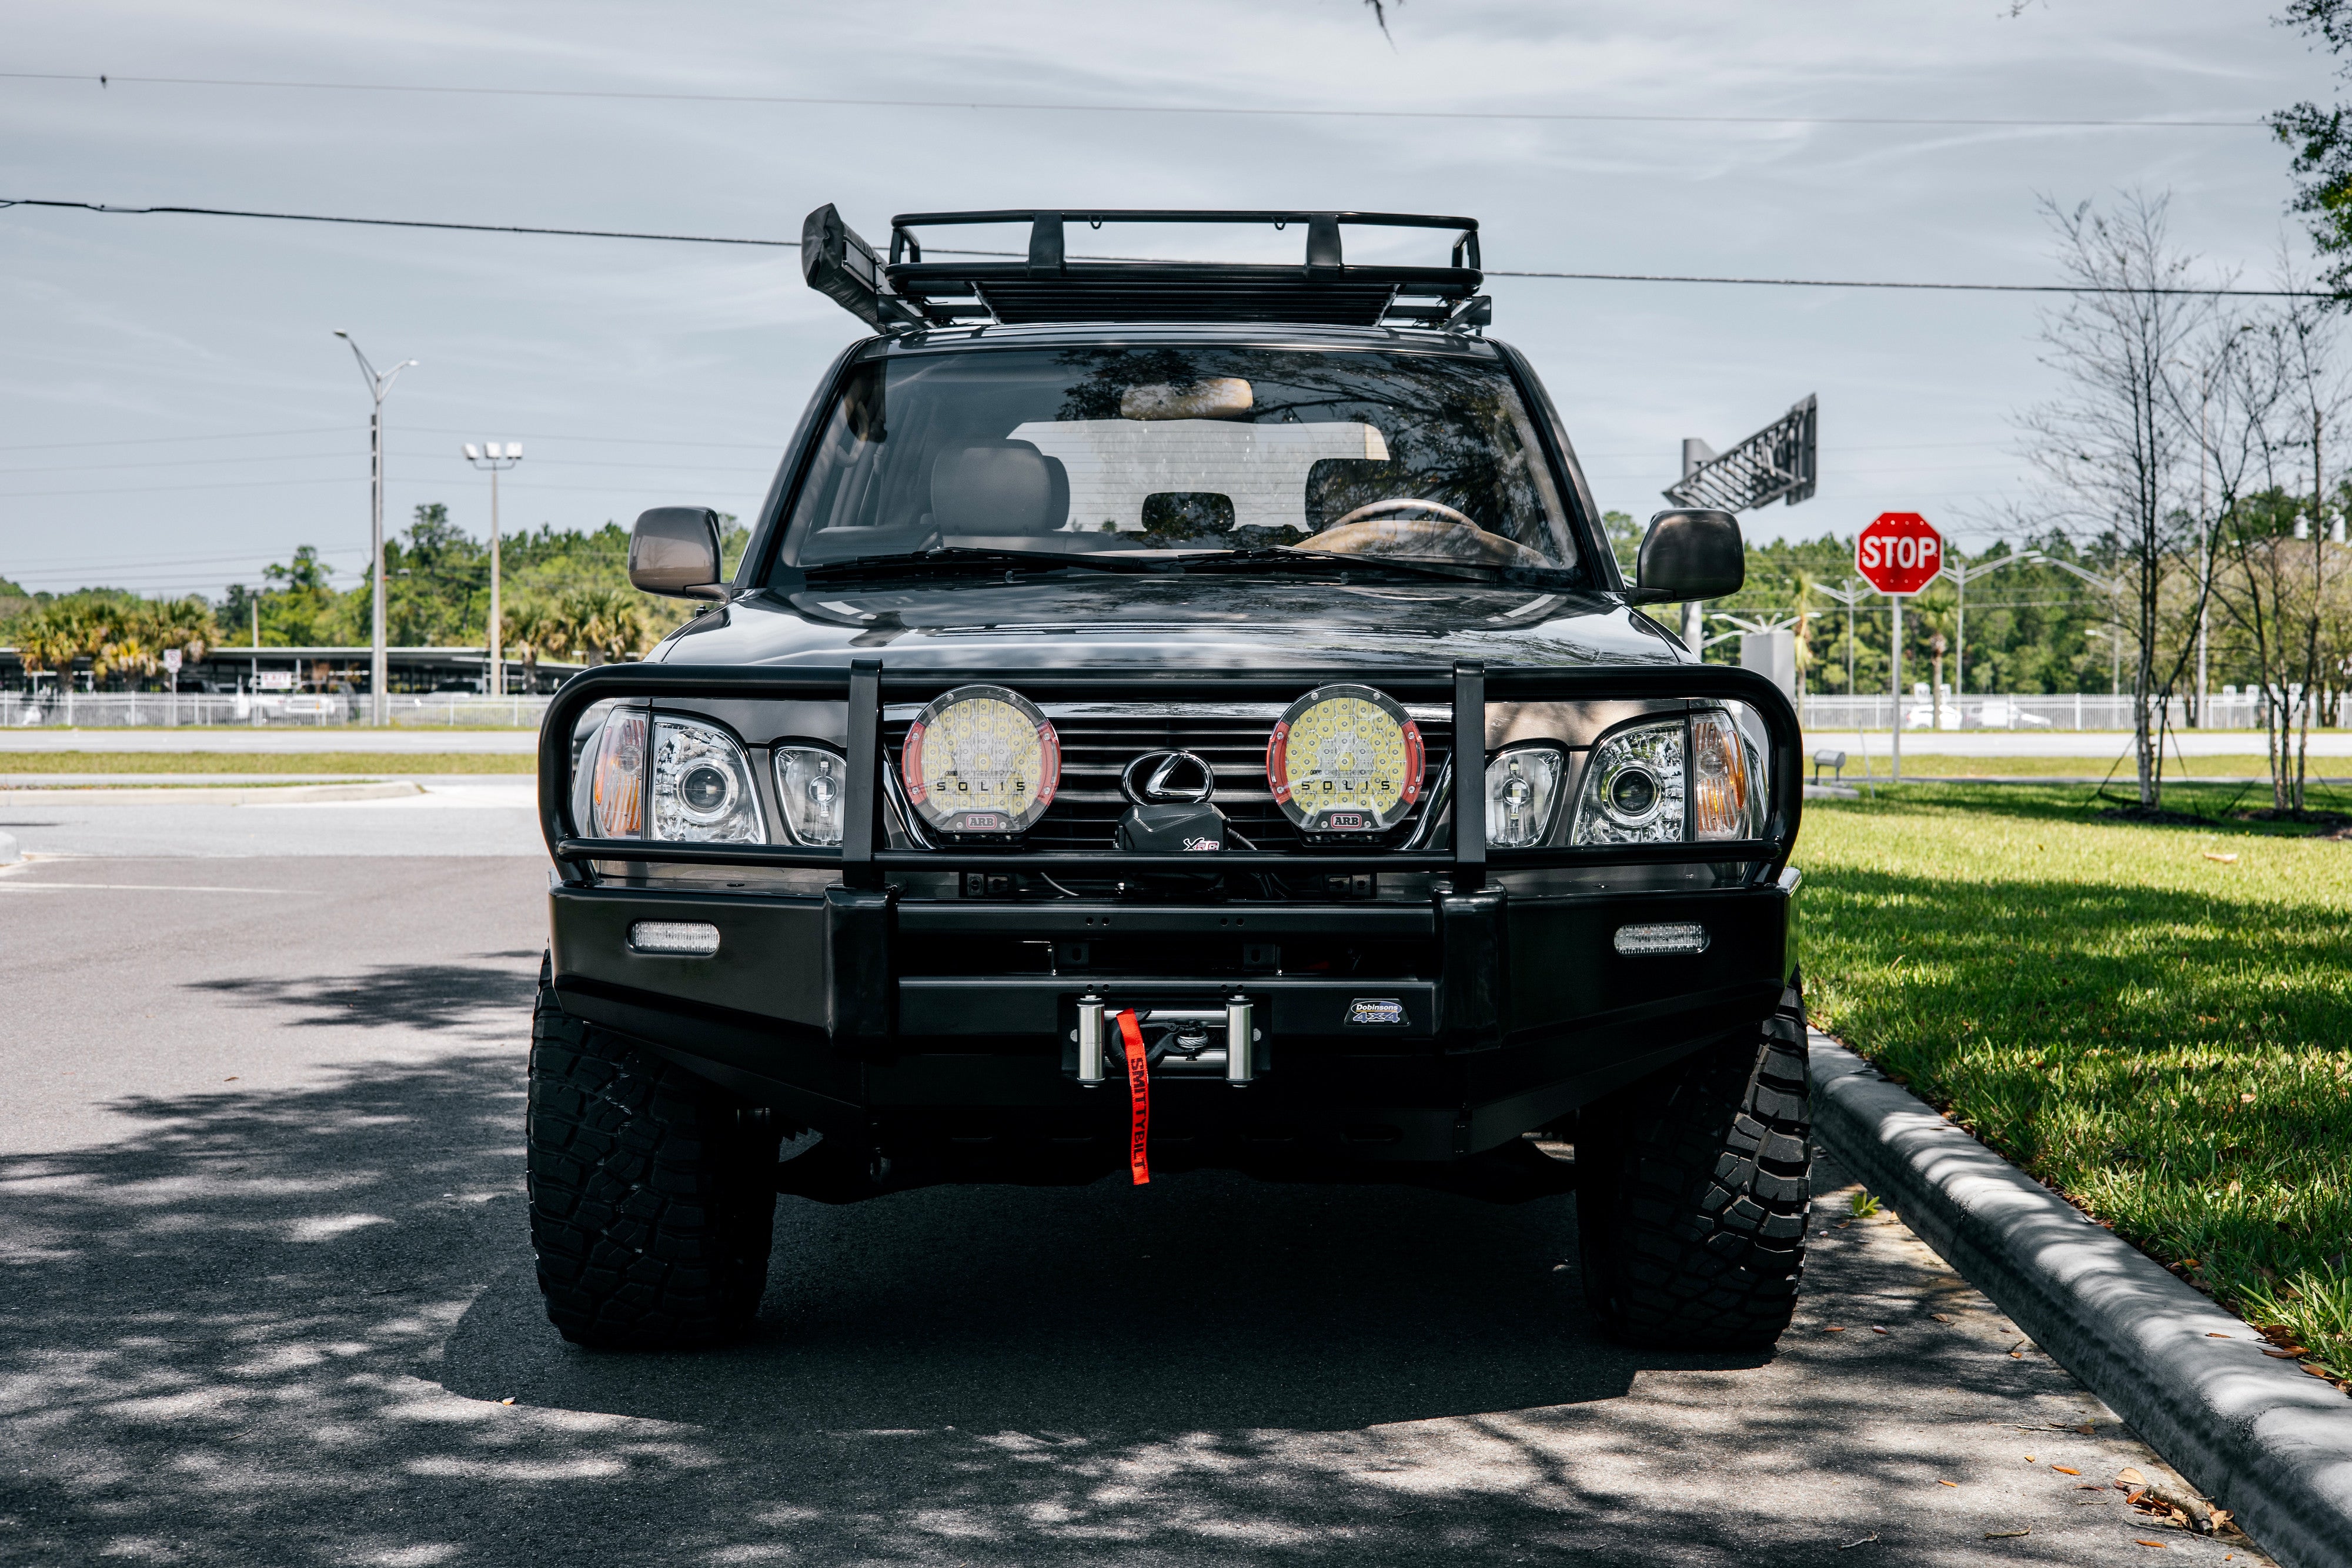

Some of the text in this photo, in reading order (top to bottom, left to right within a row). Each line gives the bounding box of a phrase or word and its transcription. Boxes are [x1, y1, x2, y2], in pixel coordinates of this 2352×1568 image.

[1861, 536, 1937, 569] STOP
[937, 782, 1025, 791] SOLIS
[1302, 781, 1390, 790] SOLIS
[969, 817, 994, 826] ARB
[1334, 817, 1359, 825] ARB
[1130, 1057, 1147, 1169] SMITTYBILT
